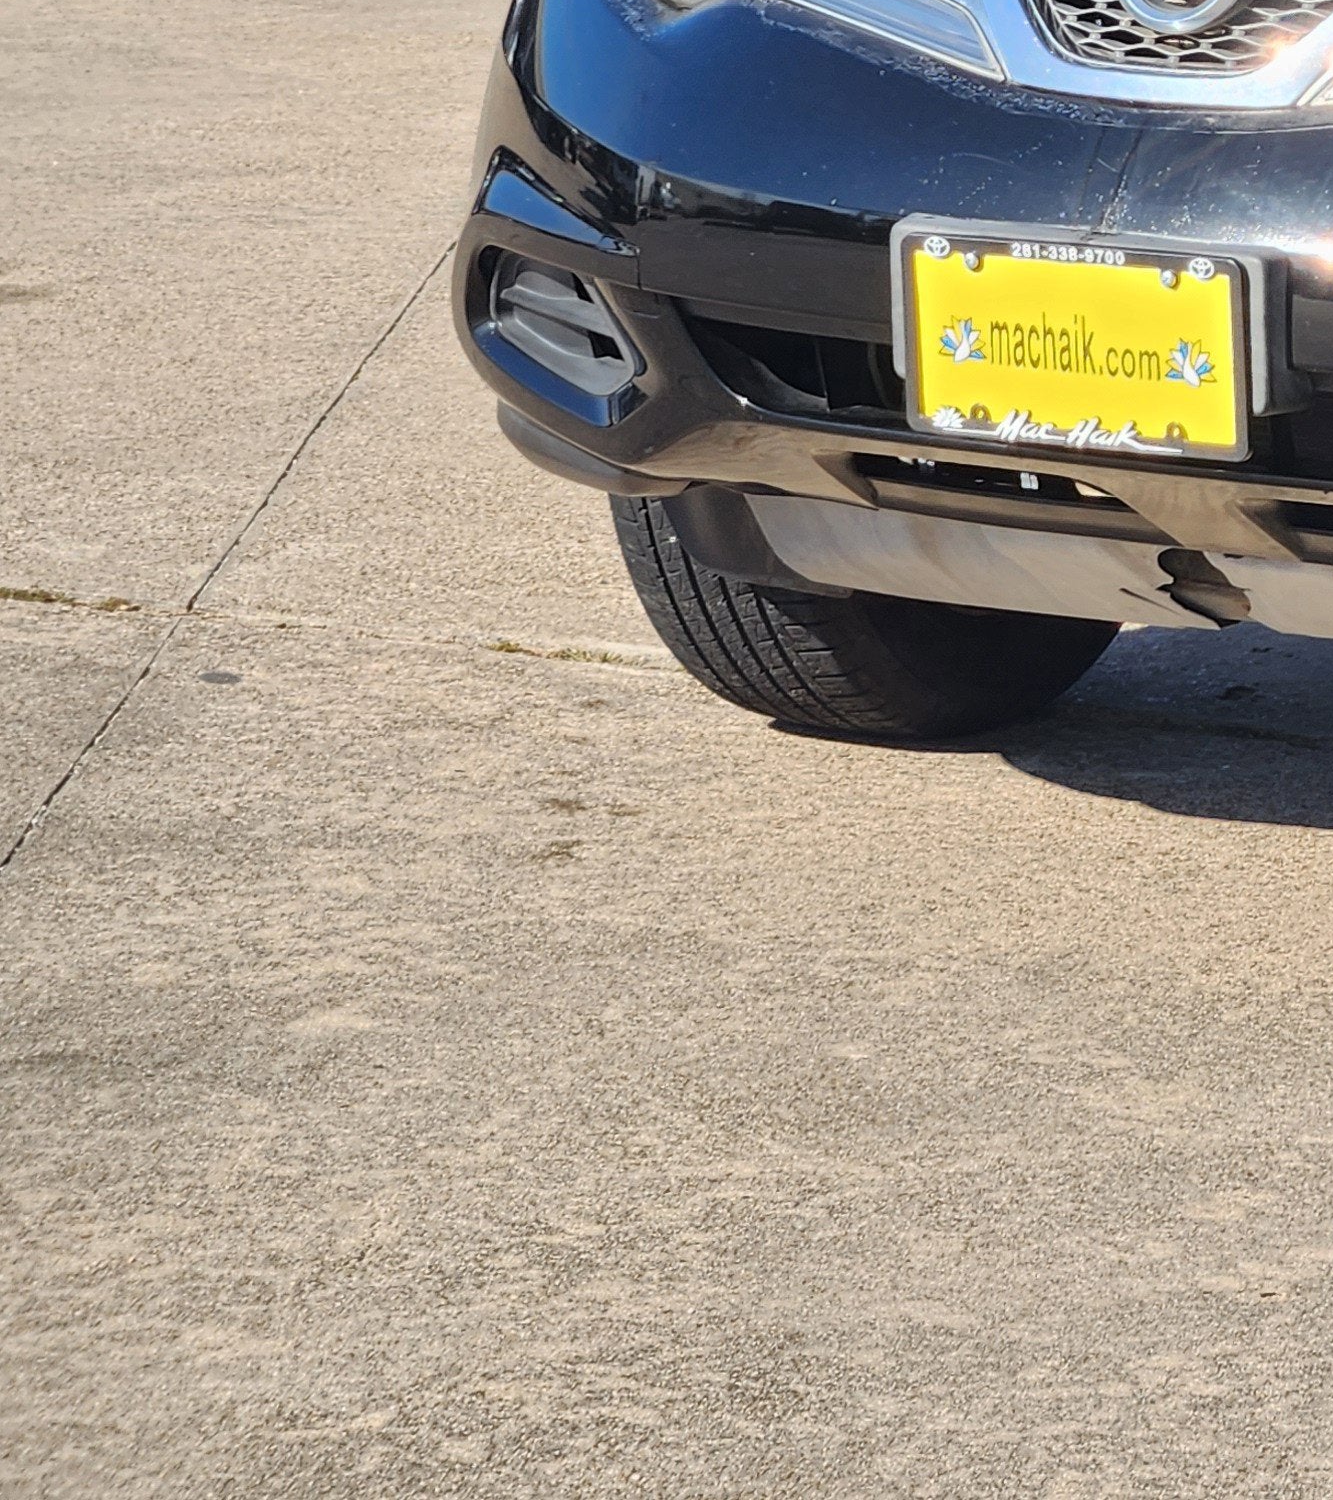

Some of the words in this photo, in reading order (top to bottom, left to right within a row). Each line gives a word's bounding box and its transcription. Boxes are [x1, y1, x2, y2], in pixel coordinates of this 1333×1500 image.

[1009, 241, 1127, 266] 281-338-9700
[989, 311, 1161, 381] machaik.com
[992, 408, 1066, 443] Mac
[1064, 416, 1170, 452] Haik
